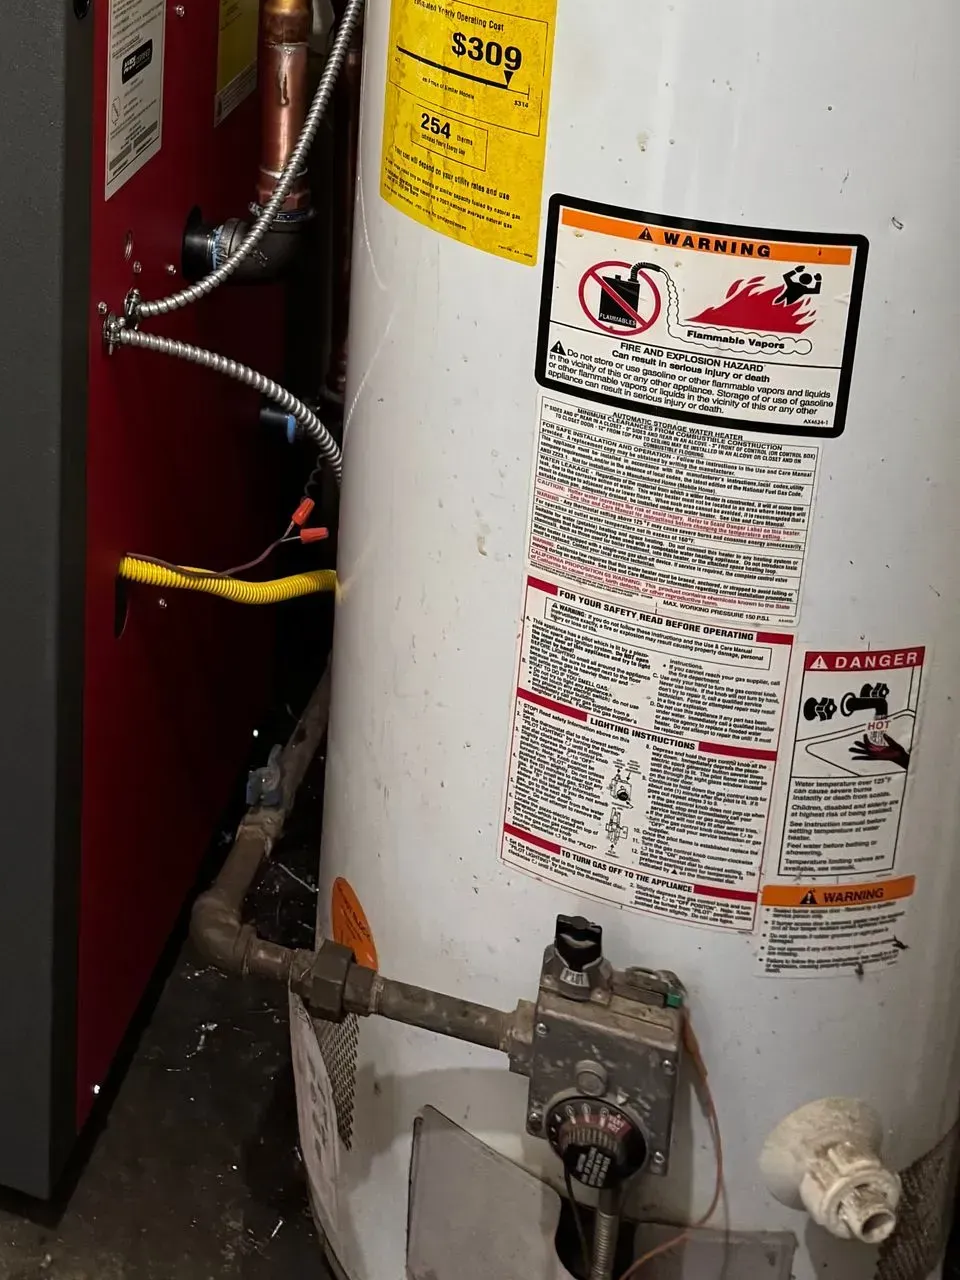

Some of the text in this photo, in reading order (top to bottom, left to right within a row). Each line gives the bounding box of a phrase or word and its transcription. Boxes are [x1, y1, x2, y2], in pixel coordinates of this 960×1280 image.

[452, 32, 522, 70] $309
[421, 113, 451, 139] 254
[664, 232, 771, 258] WARNING
[600, 312, 636, 326] FLAMMABLES
[687, 330, 785, 350] Flammable Vapors
[612, 350, 629, 360] Can
[632, 355, 656, 365] result
[658, 358, 666, 367] in
[669, 362, 702, 374] serious
[705, 367, 730, 380] injury
[745, 373, 770, 383] death
[620, 342, 764, 372] FIRE AND EXPLOSION HAZARD
[549, 352, 555, 360] in
[558, 354, 569, 364] the
[571, 358, 596, 373] vicinity
[608, 368, 621, 377] this
[633, 376, 648, 386] any
[650, 379, 671, 388] other
[673, 383, 714, 396] appliance.
[717, 390, 749, 402] Storage
[800, 400, 834, 408] gasoline
[558, 364, 577, 374] other
[578, 368, 618, 386] flammable
[620, 381, 647, 392] vapors
[659, 387, 685, 399] liquids
[687, 392, 694, 401] in
[696, 394, 710, 404] the
[711, 398, 739, 410] vicinity
[751, 402, 765, 411] this
[778, 407, 794, 416] any
[796, 407, 817, 416] other
[568, 349, 578, 359] Do
[580, 354, 592, 362] not
[594, 357, 614, 367] store
[626, 365, 640, 373] use
[642, 368, 676, 380] gasoline
[688, 377, 710, 386] other
[712, 379, 755, 392] flammable
[757, 387, 785, 396] vapors
[805, 390, 830, 400] liquids
[548, 370, 583, 386] appliance
[585, 381, 599, 390] can
[601, 385, 622, 395] result
[625, 389, 631, 397] in
[633, 392, 662, 403] serious
[664, 396, 686, 409] injury
[699, 402, 724, 414] death.
[612, 411, 744, 440] AUTOMATIC STORAGE WATER HEATER
[560, 589, 576, 601] FOR
[579, 595, 601, 609] YOUR
[603, 603, 637, 618] SAFETY
[640, 613, 663, 625] READ
[666, 618, 700, 632] BEFORE
[703, 626, 754, 640] OPERATING
[835, 652, 918, 669] DANGER
[590, 718, 695, 750] LIGHTING INSTRUCTIONS
[867, 720, 890, 731] HOT
[562, 850, 692, 892] TO TURN GAS OFF TO THE APPLIANCE
[823, 888, 884, 903] WARNING
